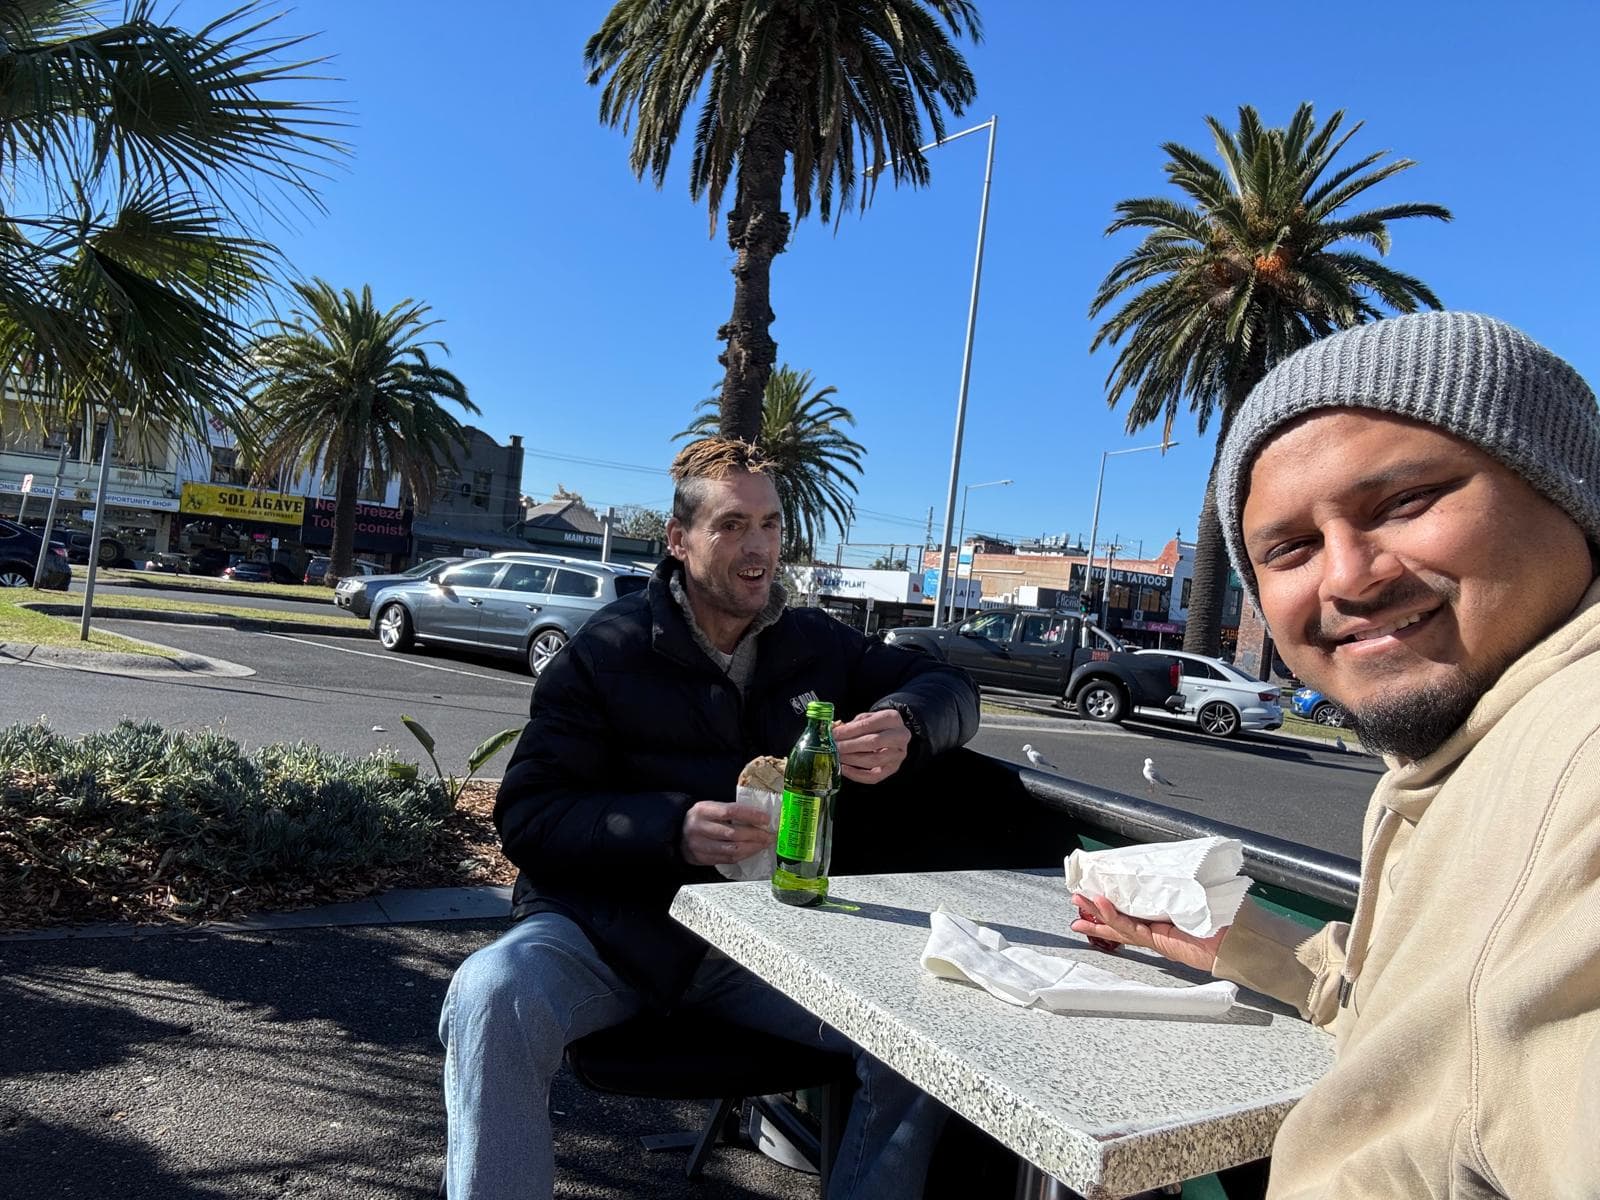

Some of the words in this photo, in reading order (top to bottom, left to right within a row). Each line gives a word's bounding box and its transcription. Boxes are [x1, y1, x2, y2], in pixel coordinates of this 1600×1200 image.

[218, 492, 247, 507] SOL
[252, 495, 303, 513] AGAVE
[564, 533, 584, 543] MAIN
[1126, 572, 1168, 587] TATTOOS
